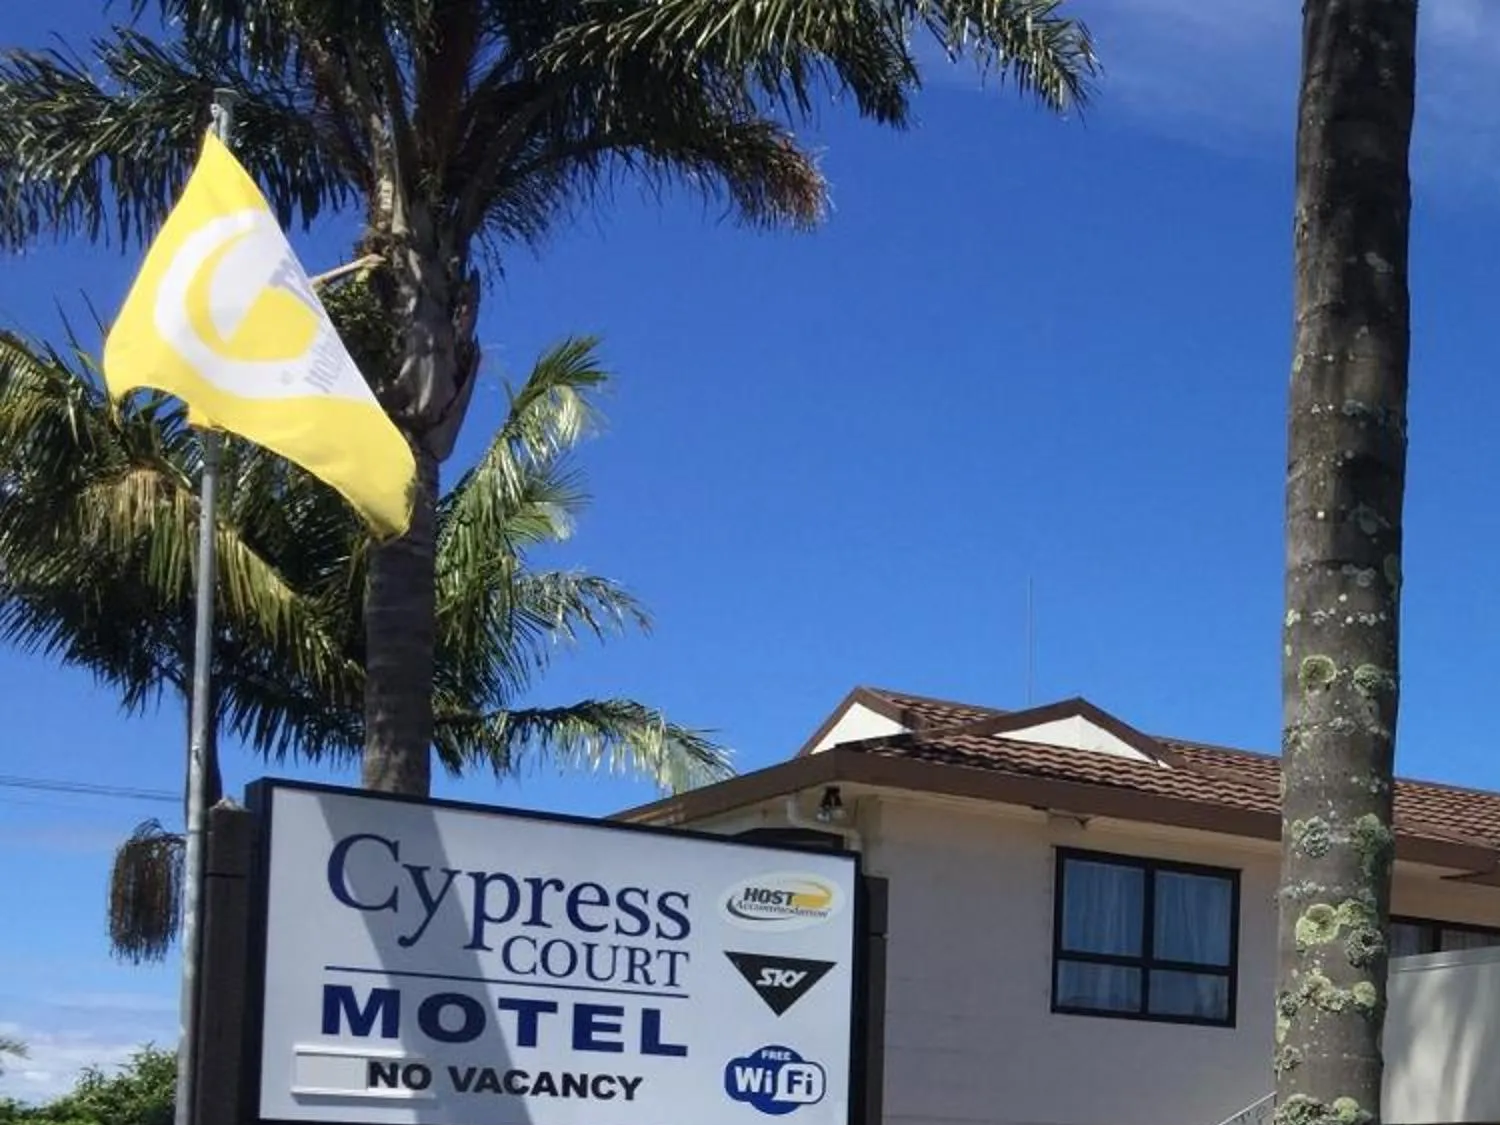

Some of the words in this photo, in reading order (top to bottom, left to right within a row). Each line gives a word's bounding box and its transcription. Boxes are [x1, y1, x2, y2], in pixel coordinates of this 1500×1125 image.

[327, 832, 691, 952] Cypress
[743, 887, 796, 906] HOST
[501, 935, 690, 987] COURT
[321, 983, 688, 1057] MOTEL
[761, 1049, 792, 1061] FREE
[367, 1060, 433, 1091] NO
[444, 1064, 644, 1101] VACANCY
